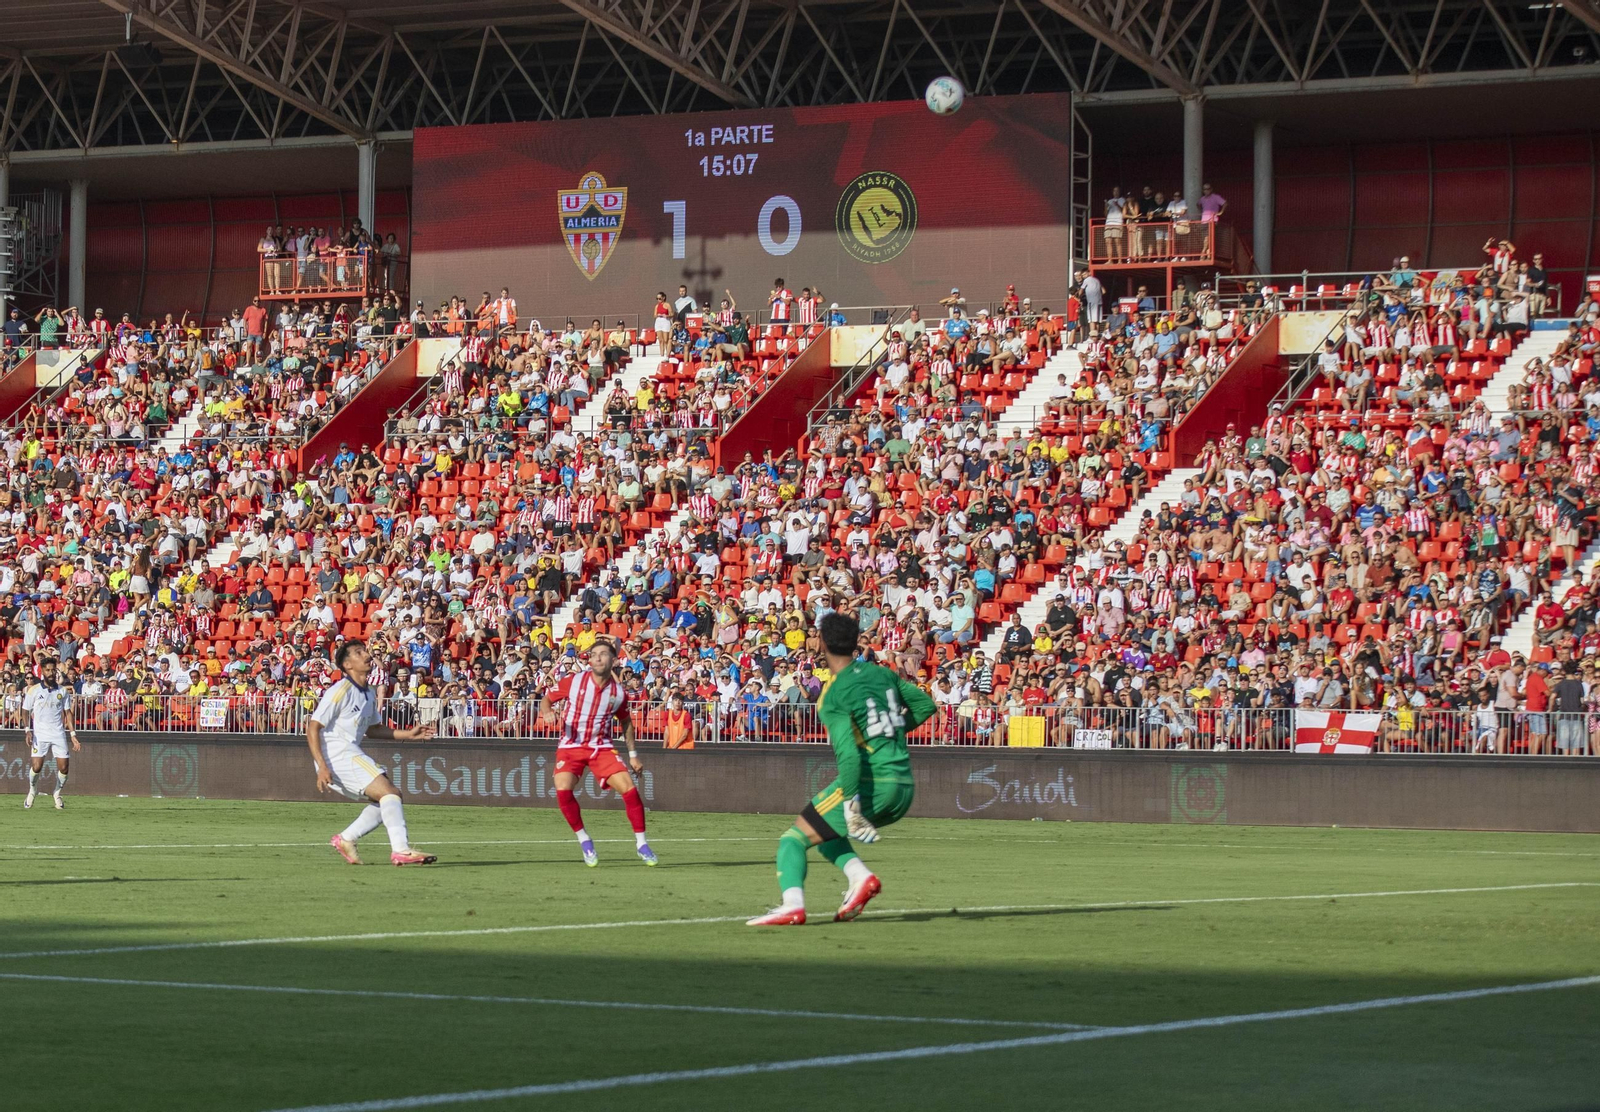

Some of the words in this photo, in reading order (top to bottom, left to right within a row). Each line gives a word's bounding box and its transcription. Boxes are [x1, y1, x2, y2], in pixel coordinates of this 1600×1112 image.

[684, 128, 705, 147] 1a
[711, 124, 774, 146] PARTE
[699, 153, 759, 177] 15:07
[857, 176, 896, 190] NASSR
[565, 196, 580, 209] U
[603, 194, 619, 208] D
[566, 216, 618, 228] ALMERIA
[663, 200, 687, 259] 1
[757, 194, 802, 257] 0
[852, 243, 881, 257] RIYADH
[866, 688, 906, 738] 44
